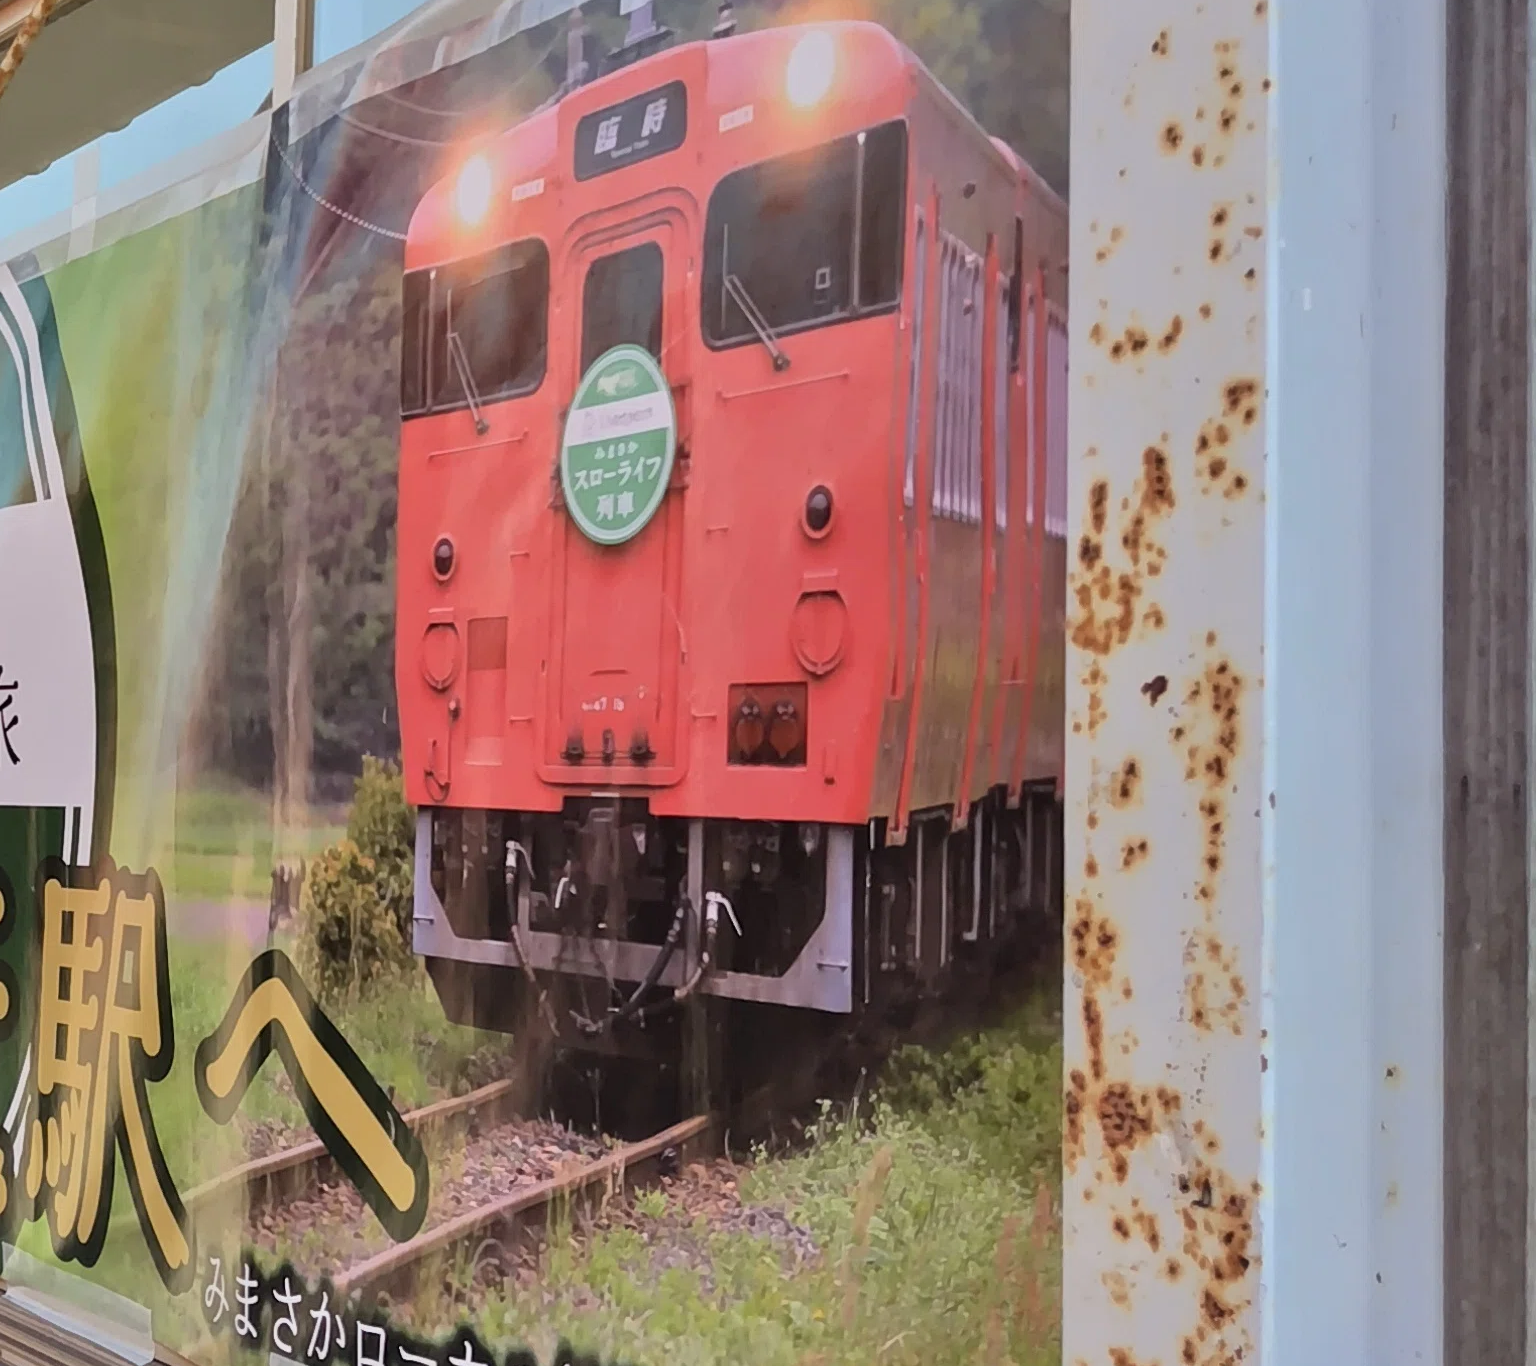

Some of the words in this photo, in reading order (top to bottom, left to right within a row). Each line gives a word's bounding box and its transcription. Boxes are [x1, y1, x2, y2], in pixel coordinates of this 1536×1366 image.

[574, 455, 662, 492] スローライフ
[595, 491, 635, 523] 列車
